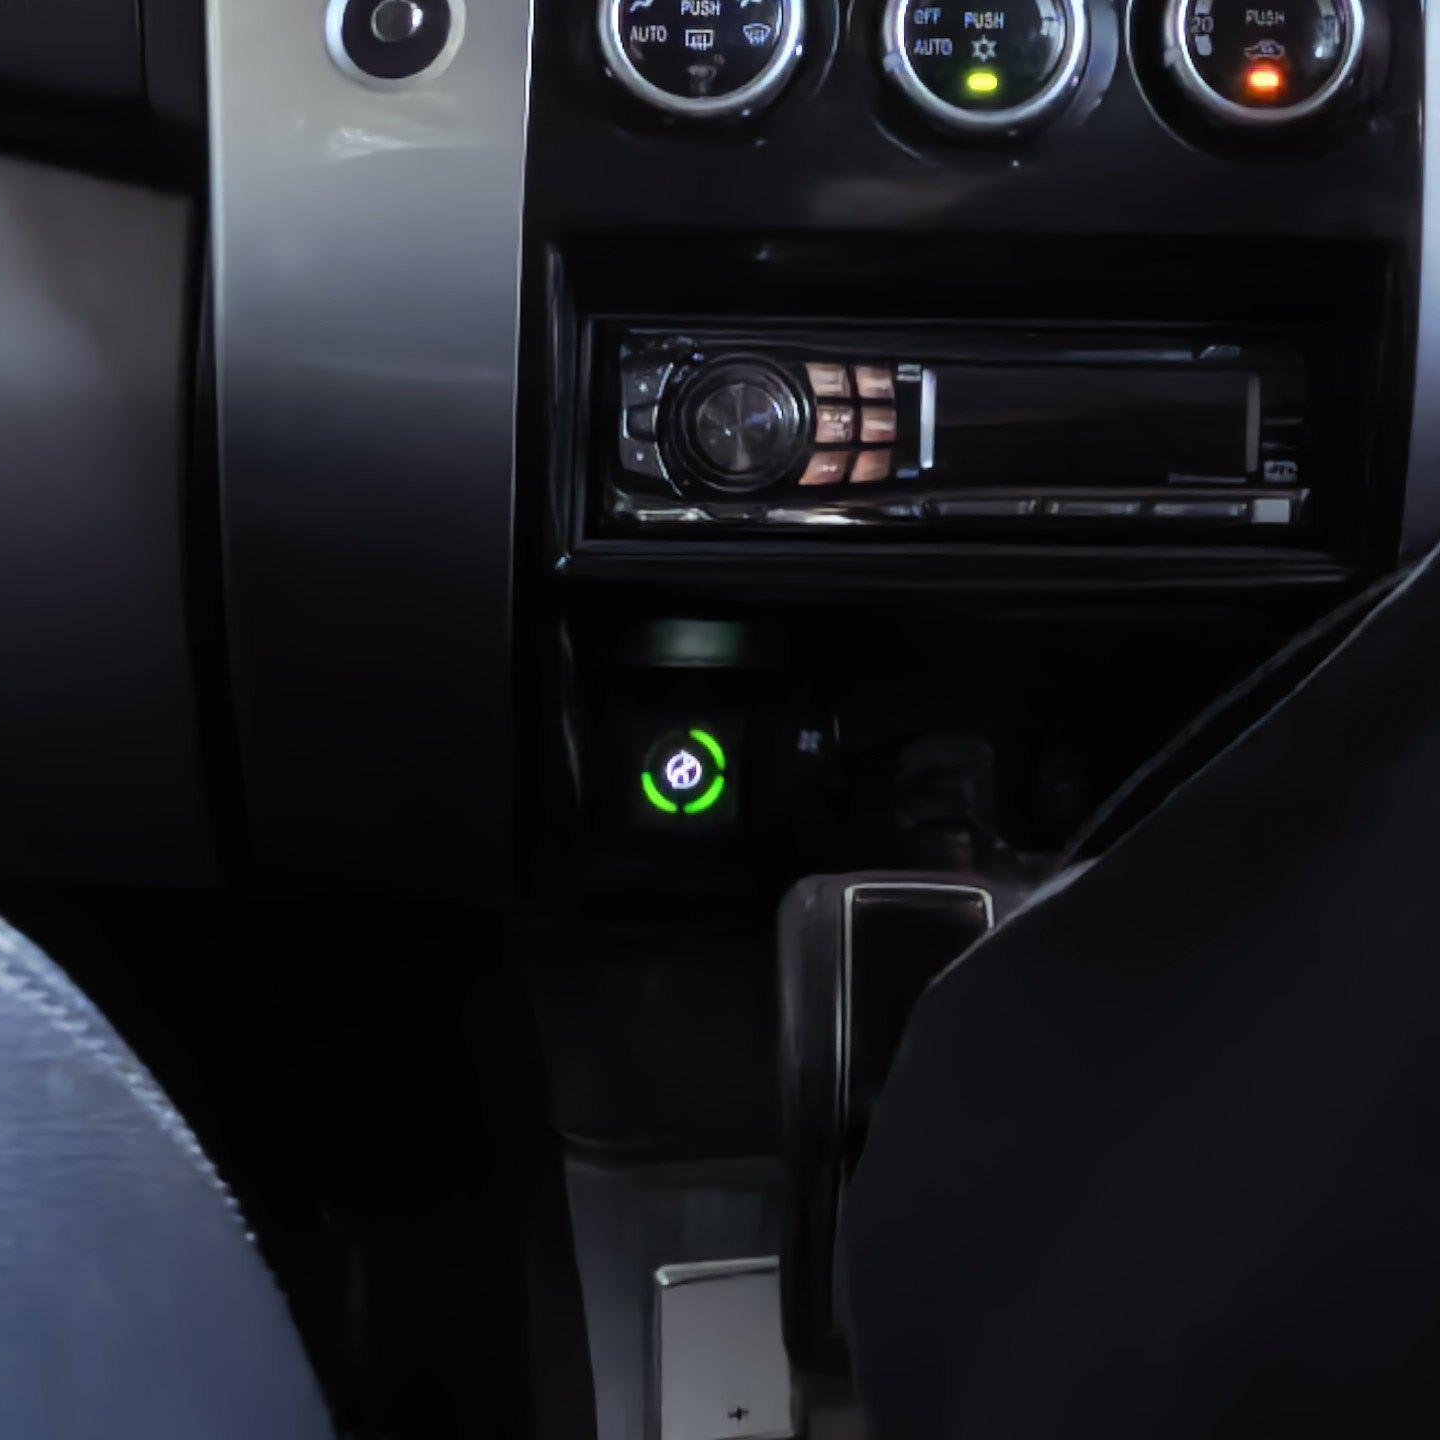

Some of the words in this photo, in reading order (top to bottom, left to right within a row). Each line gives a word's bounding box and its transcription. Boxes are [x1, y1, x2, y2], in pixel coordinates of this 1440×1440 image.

[963, 11, 1005, 30] PUSH
[1191, 15, 1214, 34] 20
[1244, 9, 1286, 26] PUSH
[629, 24, 668, 43] AUTO
[913, 37, 954, 56] AUTO
